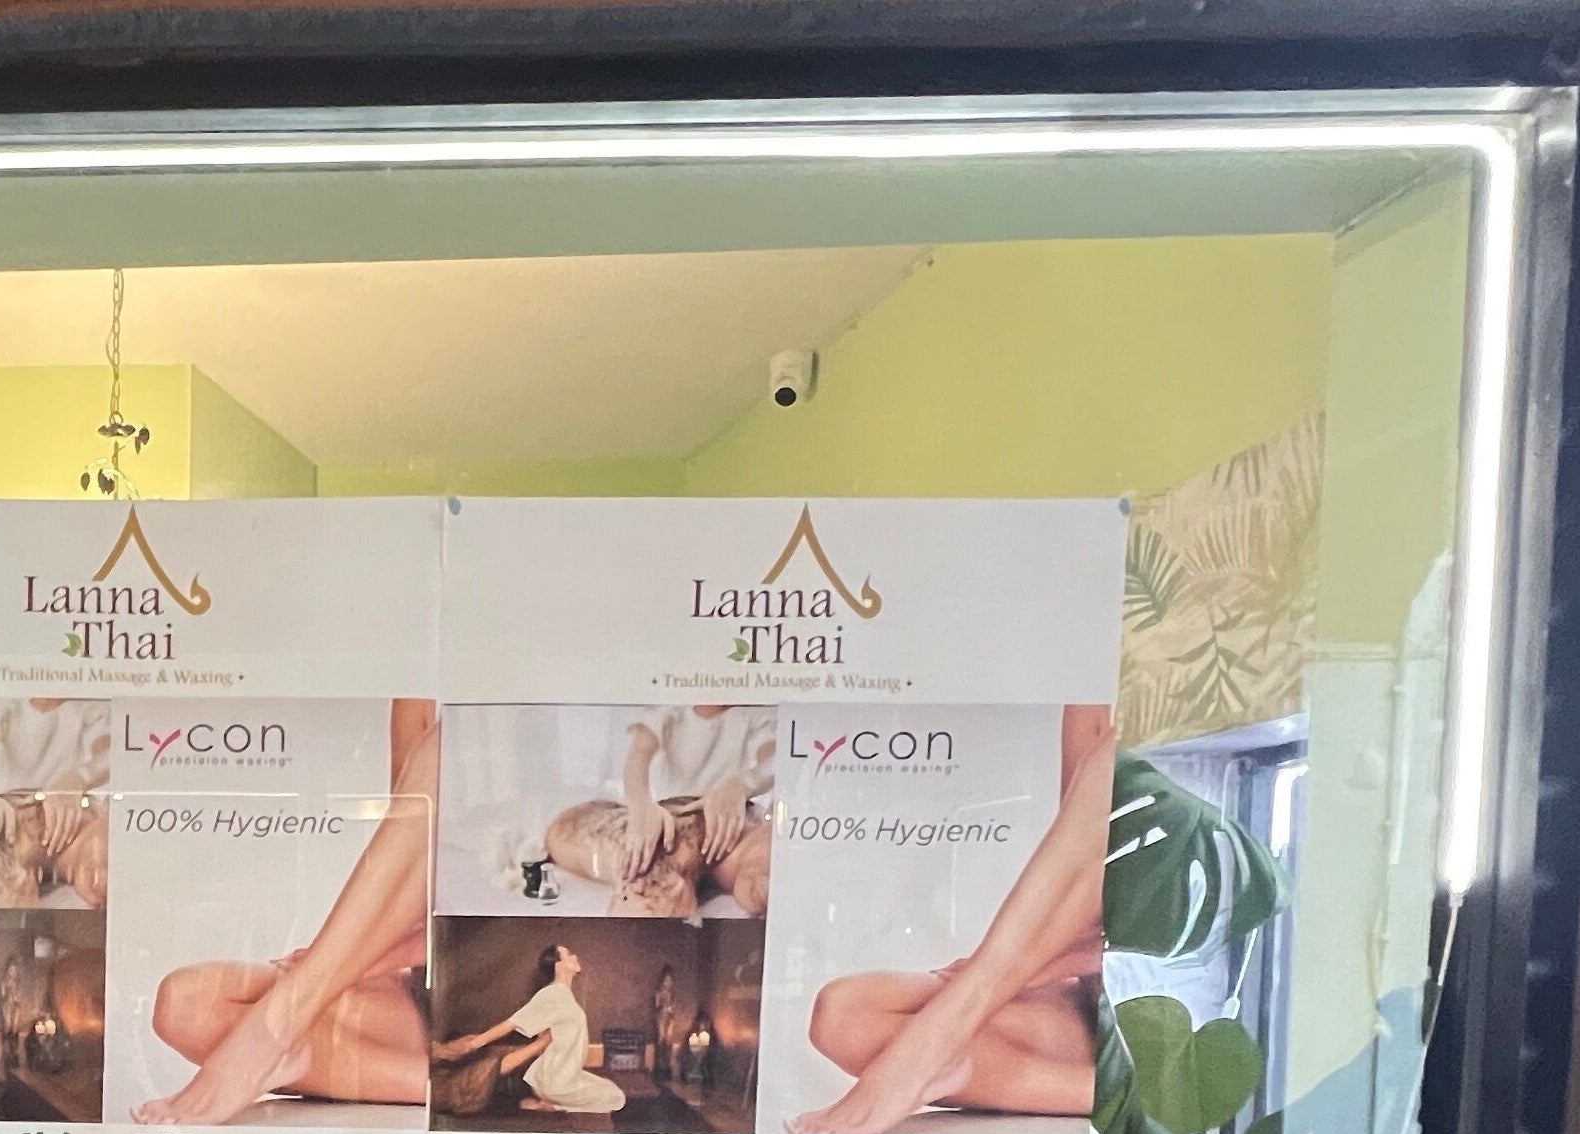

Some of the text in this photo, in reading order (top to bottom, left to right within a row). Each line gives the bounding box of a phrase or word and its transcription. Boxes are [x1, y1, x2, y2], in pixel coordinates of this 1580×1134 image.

[23, 575, 164, 616] Lanna
[690, 579, 836, 618] Lanna
[72, 619, 176, 661] Thai
[740, 622, 845, 665] Thai
[0, 666, 234, 687] Traditional Massage & Waxing
[663, 672, 902, 693] Traditional Massage & Waxing
[125, 808, 345, 838] 100% Hygienic
[789, 816, 1011, 847] 100% Hygienic
